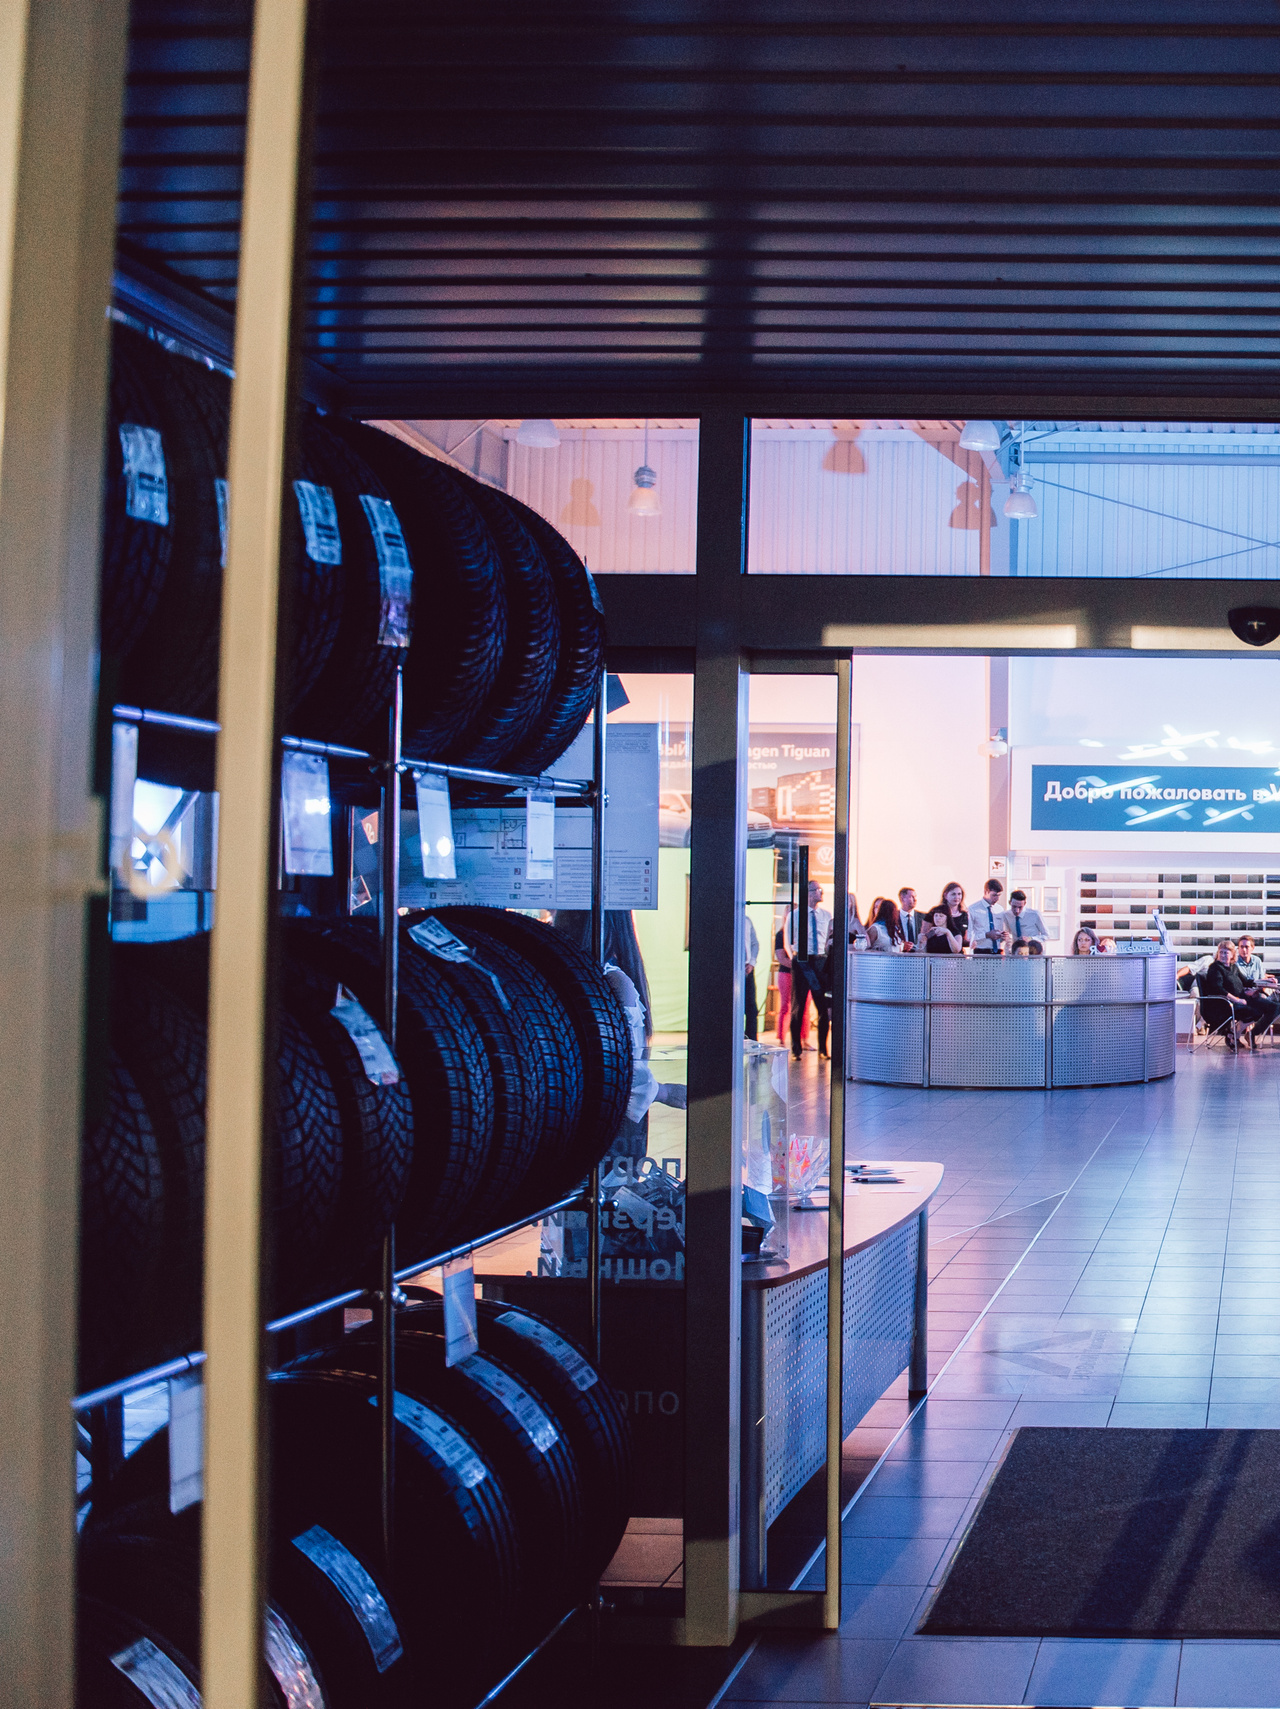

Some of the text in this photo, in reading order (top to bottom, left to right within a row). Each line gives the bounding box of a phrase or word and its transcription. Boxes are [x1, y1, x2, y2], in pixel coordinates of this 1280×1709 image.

[781, 744, 831, 761] Tiguan
[1044, 780, 1114, 804] Добро
[1120, 786, 1247, 802] пожаловать
[1252, 789, 1264, 802] в
